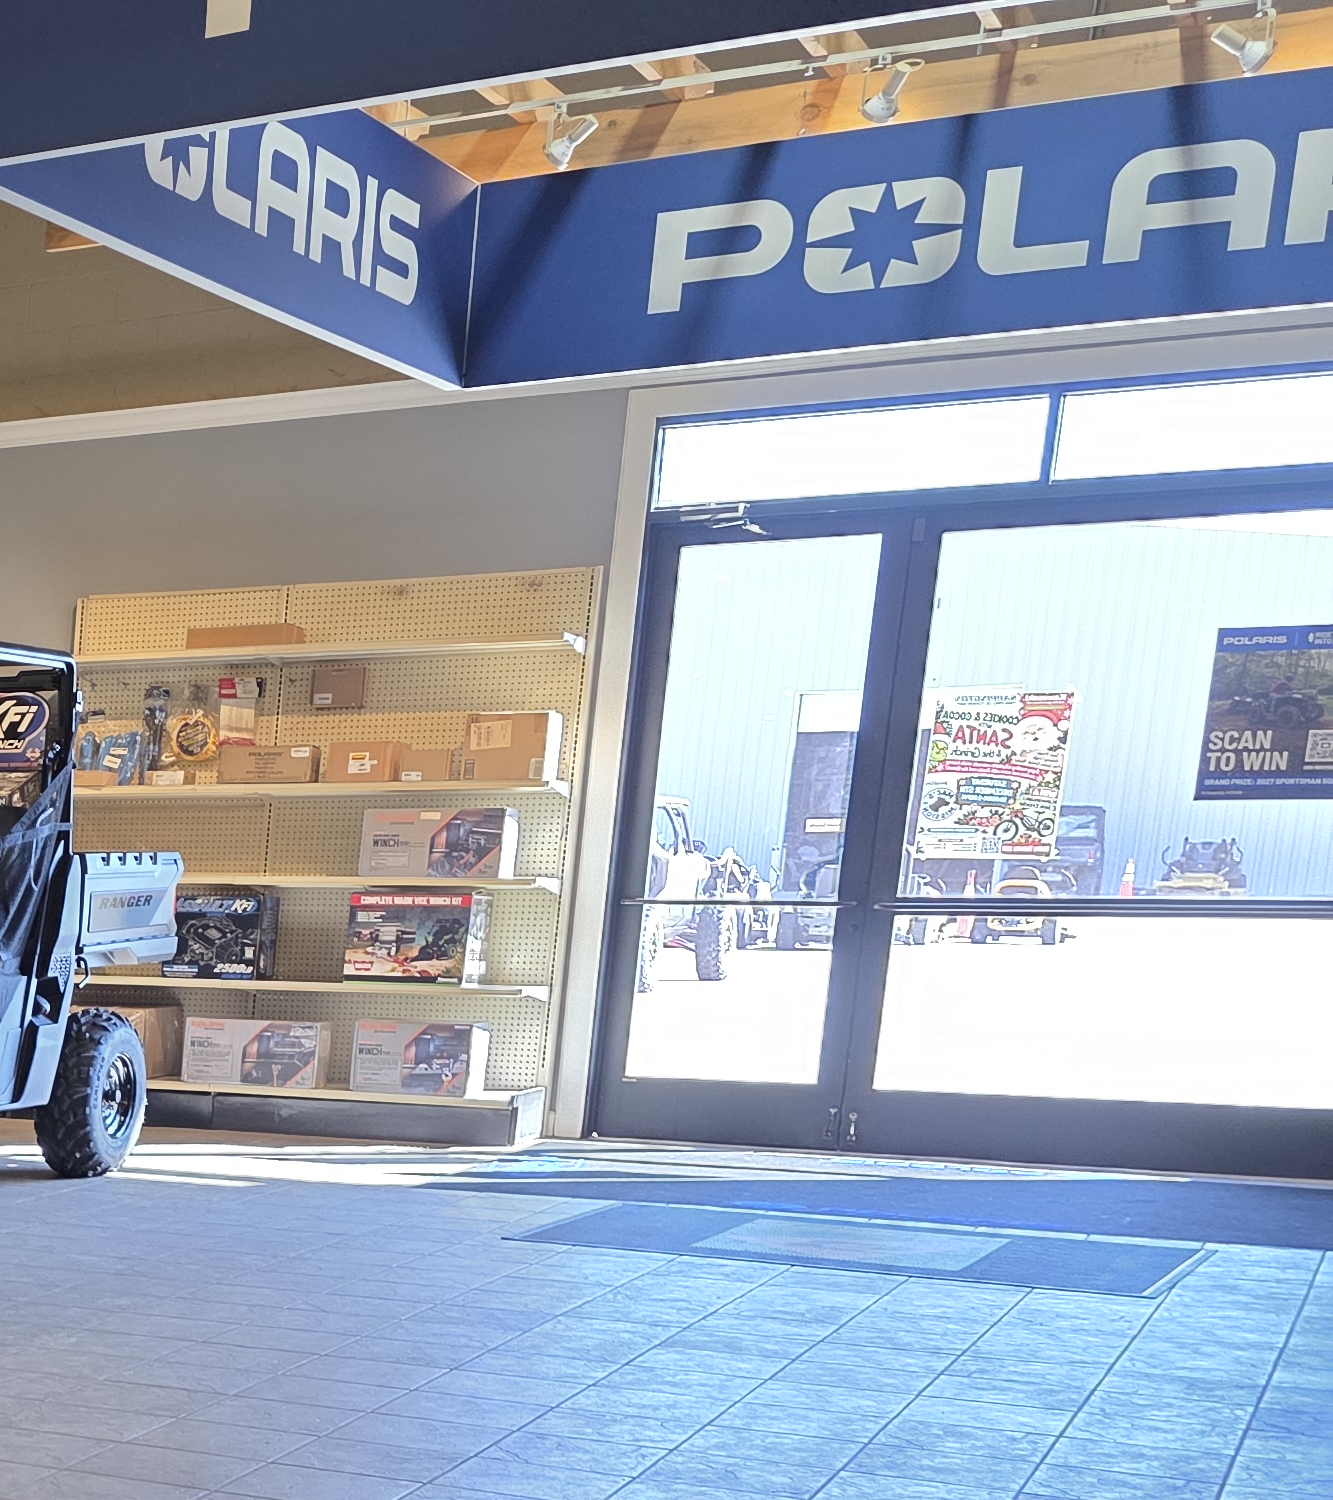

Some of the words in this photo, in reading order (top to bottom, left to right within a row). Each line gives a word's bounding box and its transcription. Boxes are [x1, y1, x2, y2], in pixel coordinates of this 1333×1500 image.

[145, 119, 420, 306] OLARIS
[1223, 636, 1287, 645] POLARIS
[1208, 730, 1273, 750] SCAN
[1207, 752, 1236, 771] TO
[1243, 751, 1288, 771] WIN
[372, 838, 399, 848] WINCH
[99, 895, 153, 910] RANGER
[360, 896, 393, 904] COMPLETE
